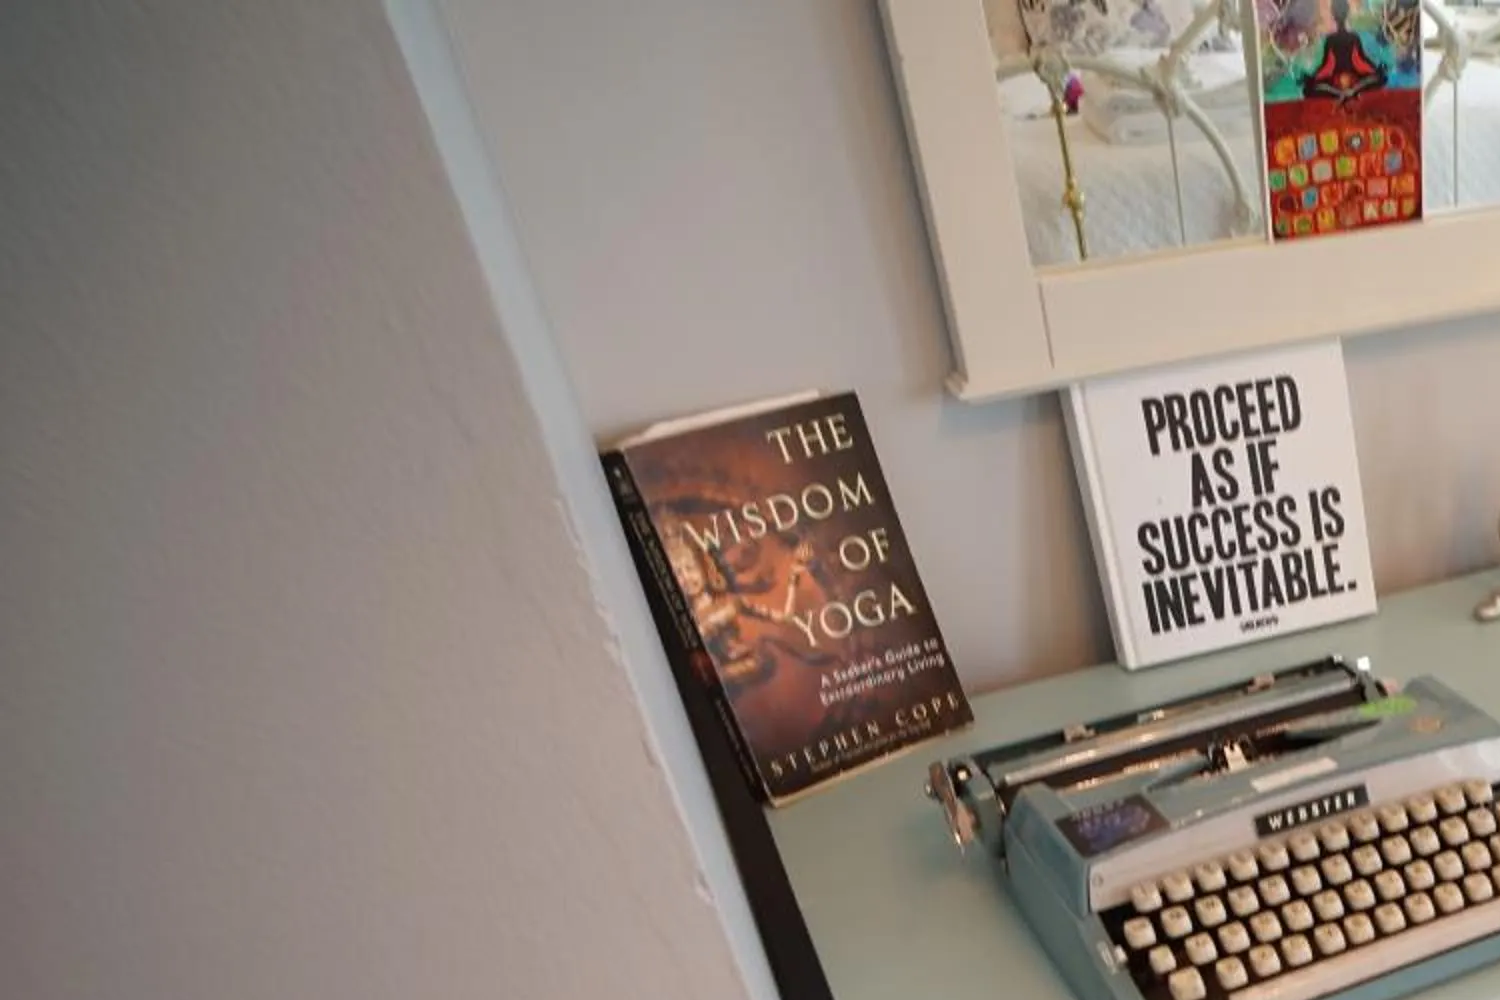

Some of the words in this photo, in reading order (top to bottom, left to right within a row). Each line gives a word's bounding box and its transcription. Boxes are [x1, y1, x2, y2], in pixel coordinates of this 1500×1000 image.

[767, 412, 855, 465] THE
[1142, 375, 1301, 455] PROCEED
[1191, 448, 1239, 508] AS
[1246, 439, 1279, 496] IF
[682, 471, 875, 553] WISDOM
[1137, 496, 1301, 576] SUCCESS
[1308, 486, 1345, 543] IS
[838, 527, 890, 572] OF
[793, 584, 916, 649] YOGA
[1142, 544, 1357, 635] INEVITABLE.
[820, 667, 905, 707] Extraordinary
[907, 652, 945, 675] Living
[821, 673, 831, 688] A
[833, 656, 882, 683] Seeker's
[885, 643, 920, 665] Guide
[923, 638, 938, 652] to
[770, 720, 880, 777] STEPHEN
[895, 692, 959, 727] COPE
[1268, 791, 1356, 831] WEBSTER
